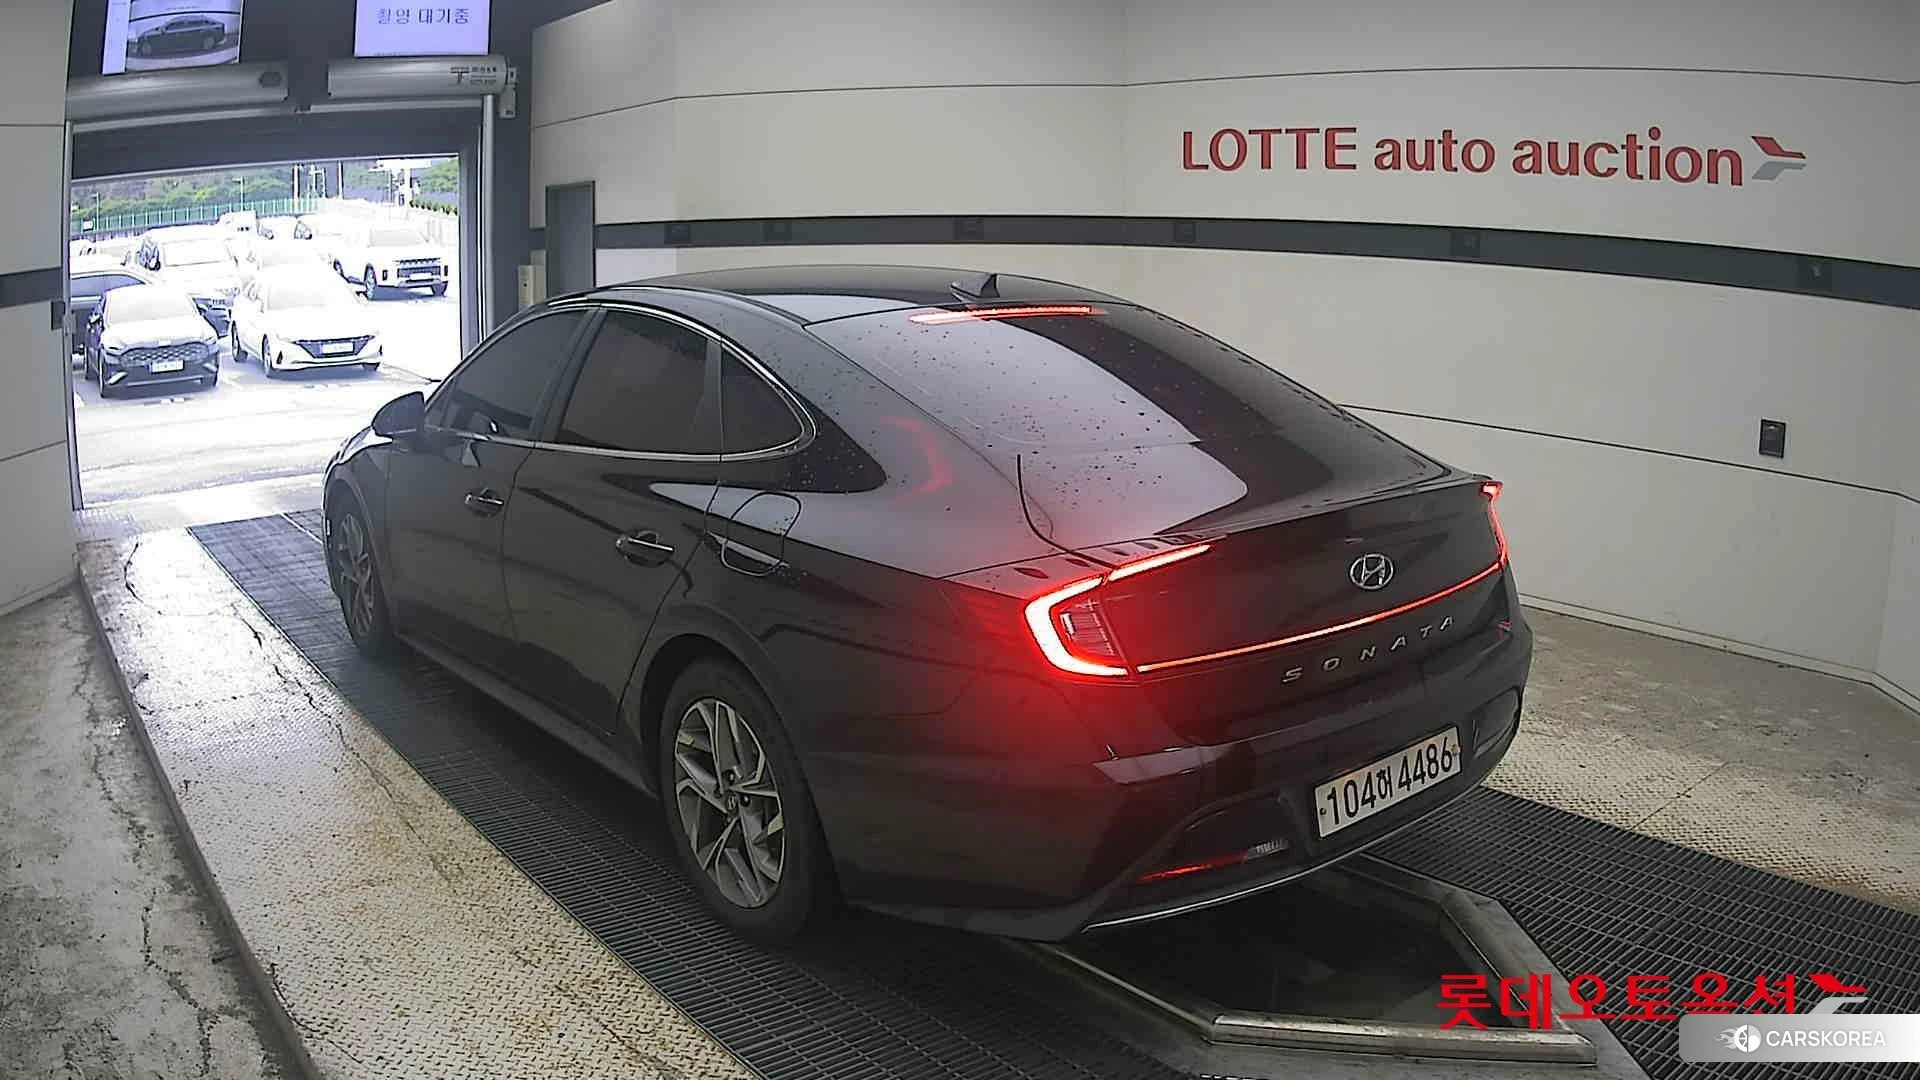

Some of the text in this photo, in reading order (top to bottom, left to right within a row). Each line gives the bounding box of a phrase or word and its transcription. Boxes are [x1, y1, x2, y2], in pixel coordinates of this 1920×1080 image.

[418, 8, 469, 24] 대기중
[1182, 126, 1744, 187] LOTTE auto auction
[1281, 615, 1454, 683] SONATA
